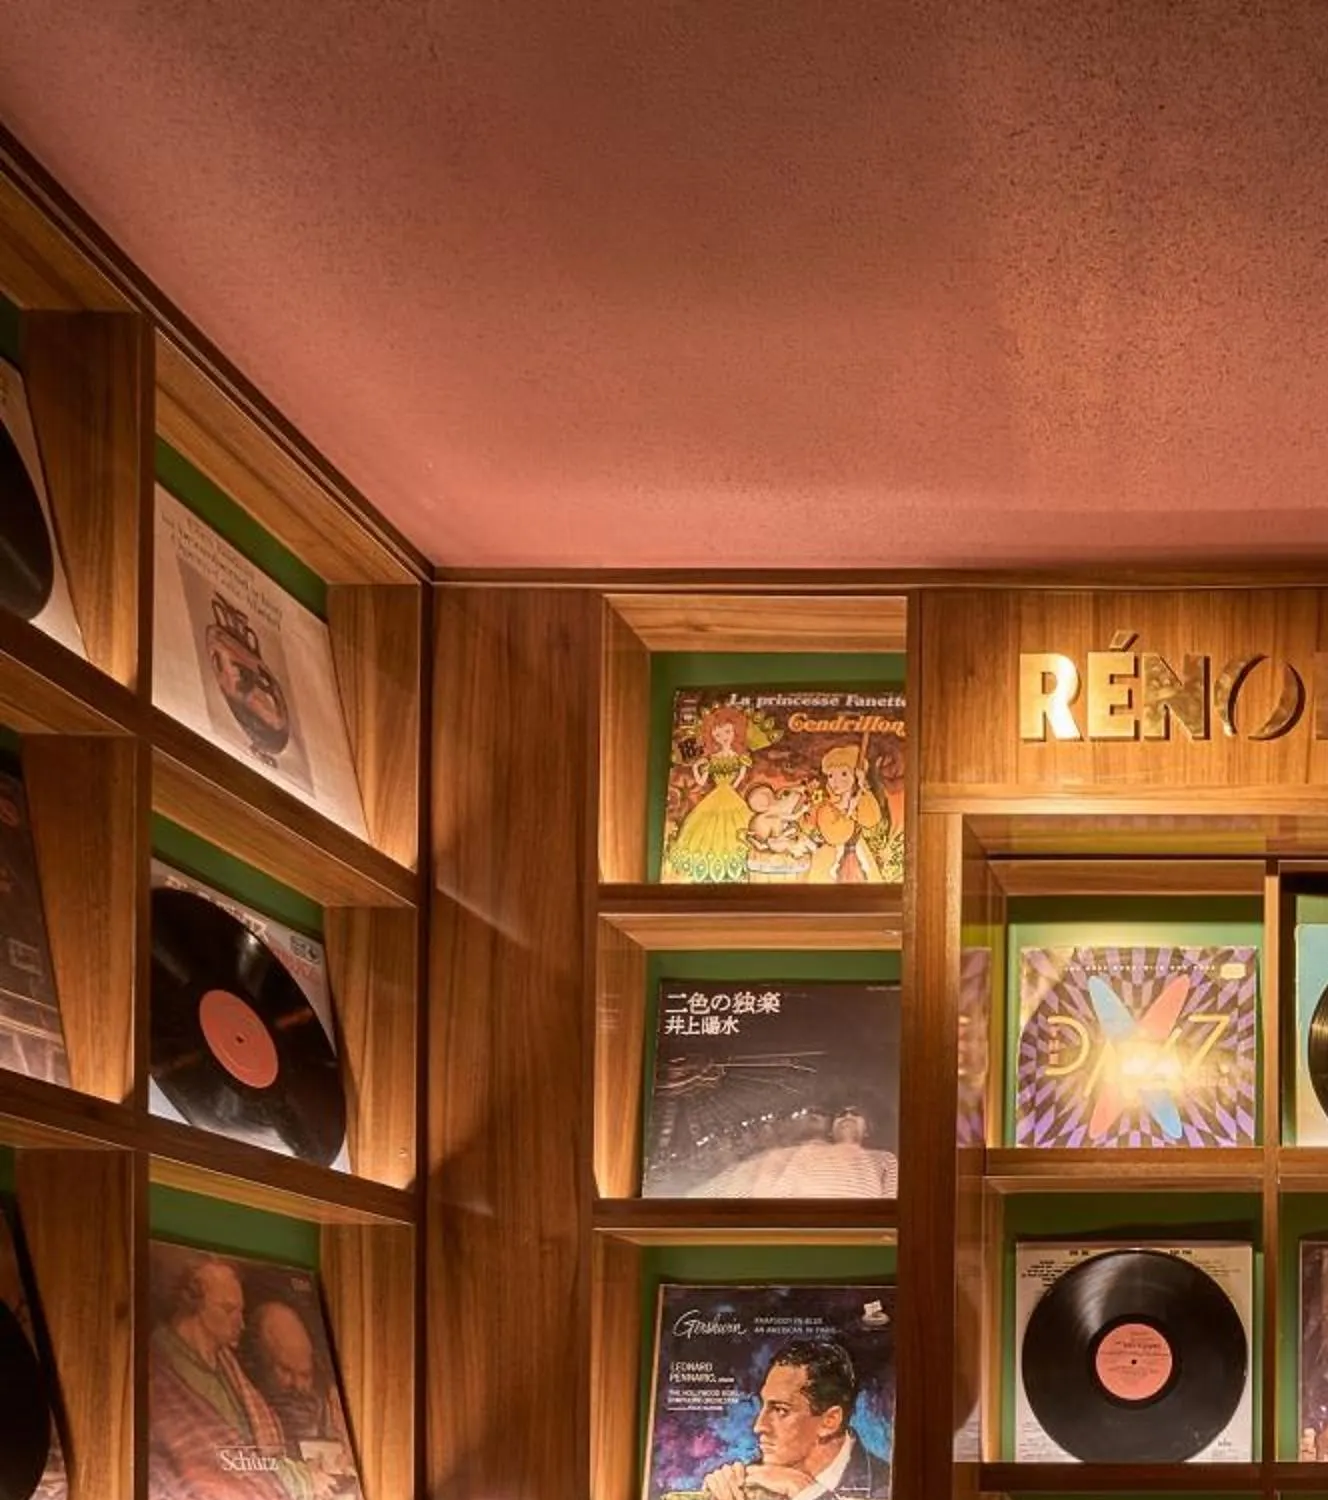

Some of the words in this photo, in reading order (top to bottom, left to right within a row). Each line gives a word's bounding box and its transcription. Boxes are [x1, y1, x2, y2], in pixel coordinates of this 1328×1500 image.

[756, 694, 840, 709] princesse
[787, 712, 904, 737] Cendrillon
[665, 990, 781, 1014] 二色の独楽
[671, 1361, 714, 1372] LEONARD
